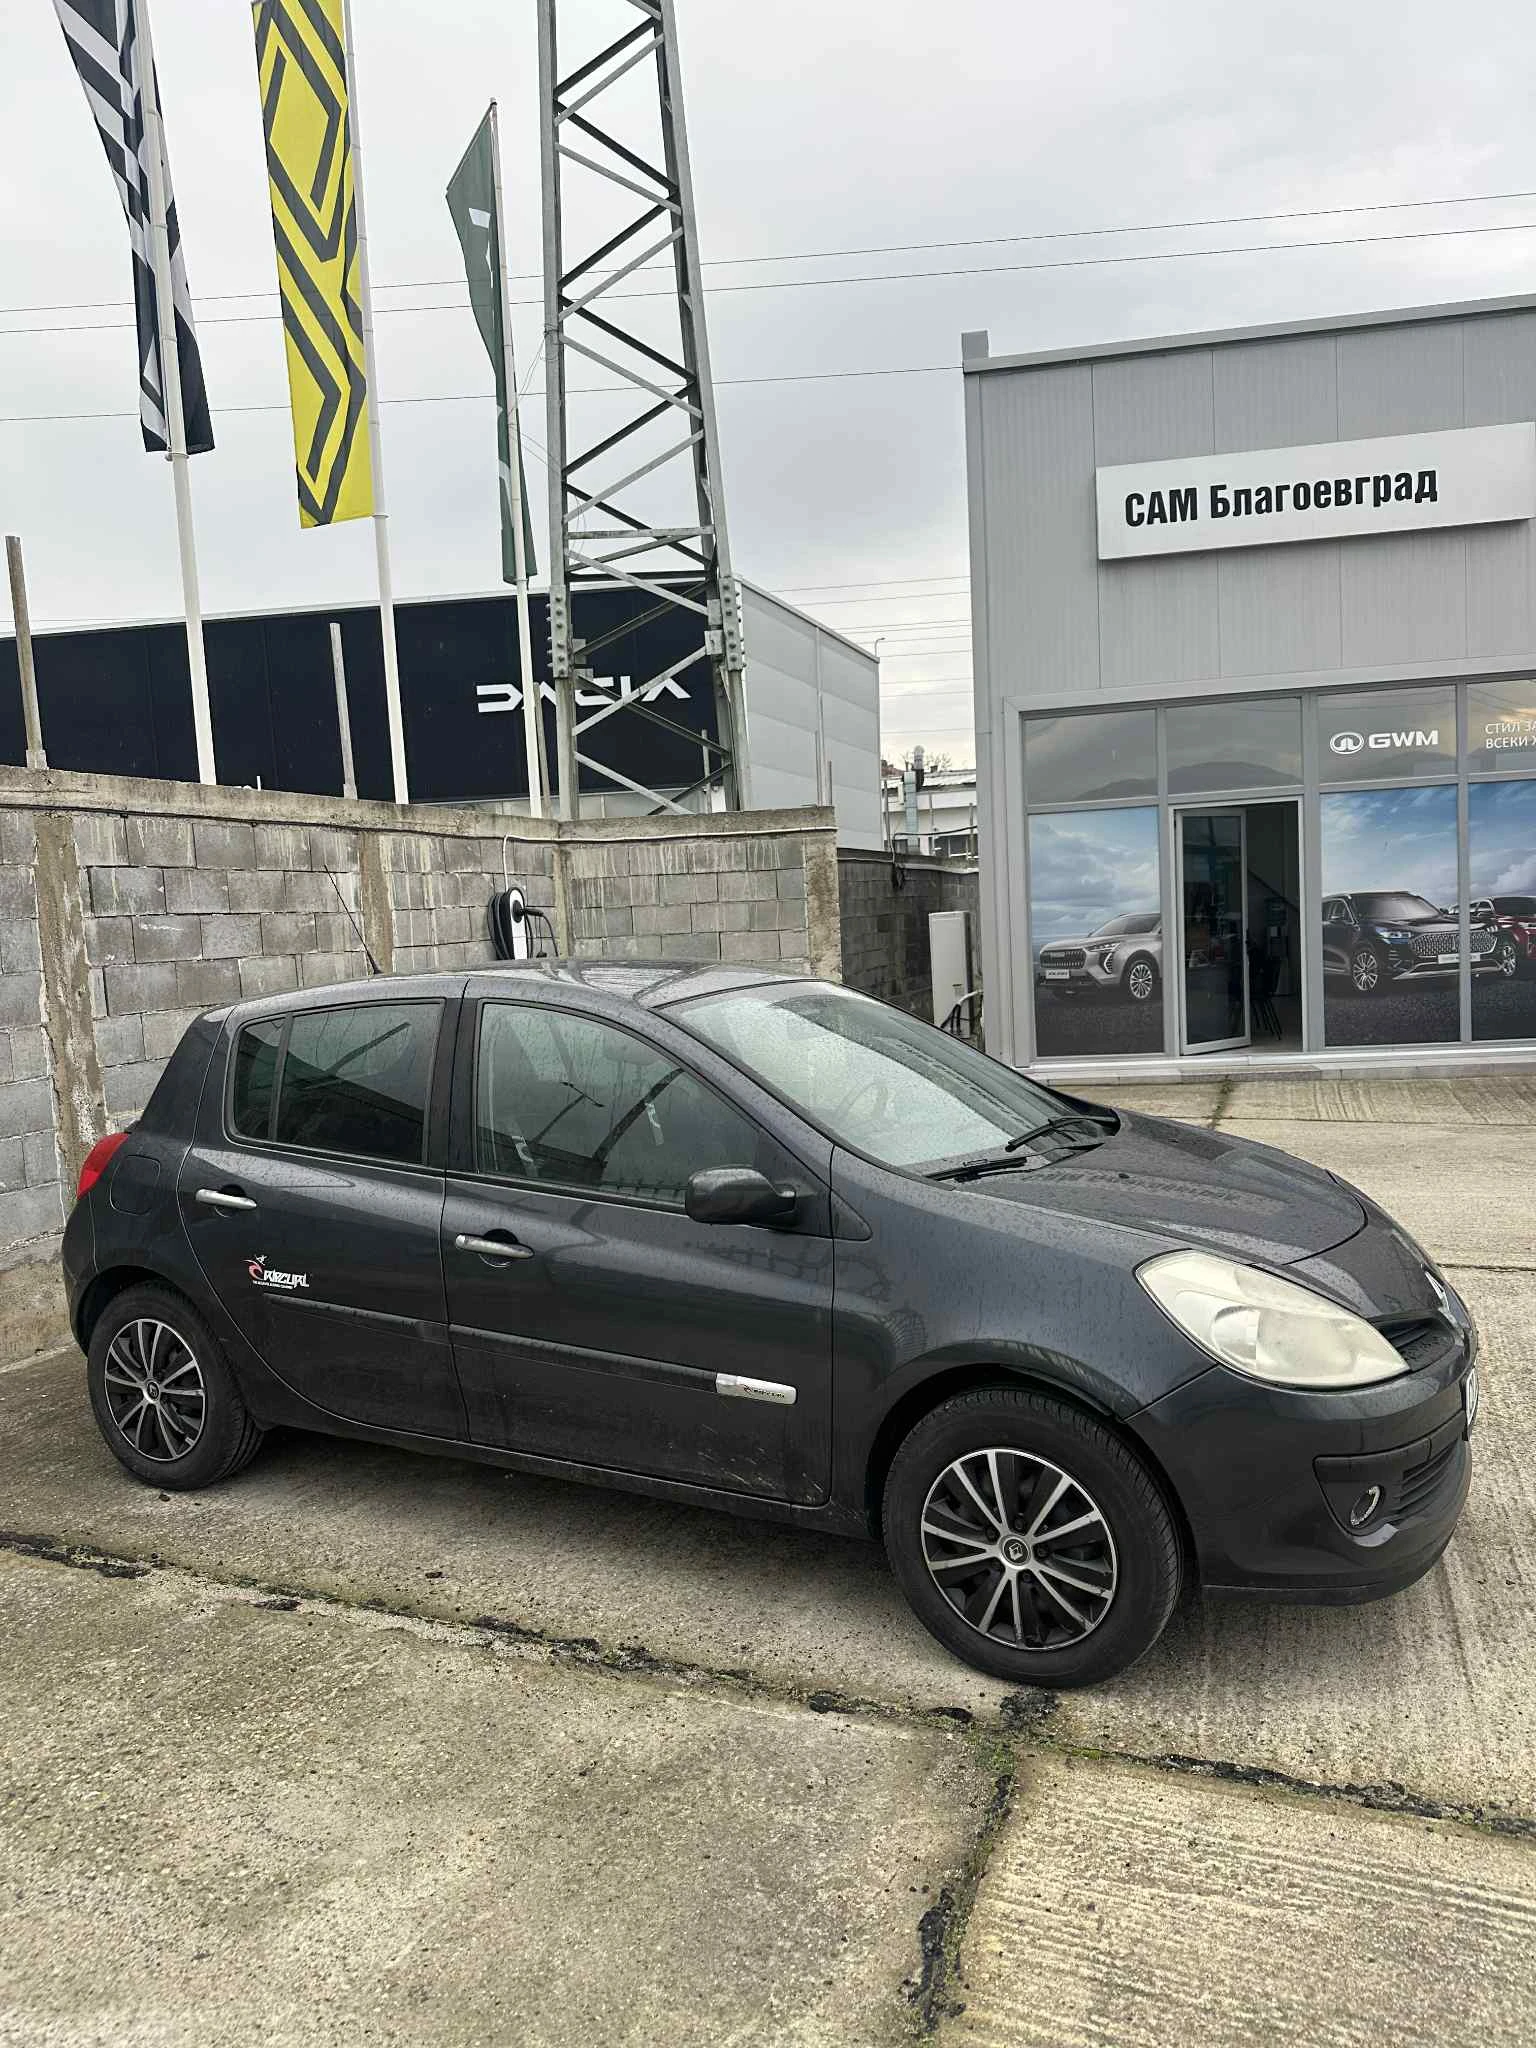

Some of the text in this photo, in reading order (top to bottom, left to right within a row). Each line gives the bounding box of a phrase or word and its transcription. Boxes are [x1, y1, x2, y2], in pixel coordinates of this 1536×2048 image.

[1125, 469, 1438, 527] САМ Благоевград
[1485, 722, 1520, 735] СТИЛ
[1368, 730, 1439, 749] GWM
[1485, 735, 1528, 749] ВСЕКИ
